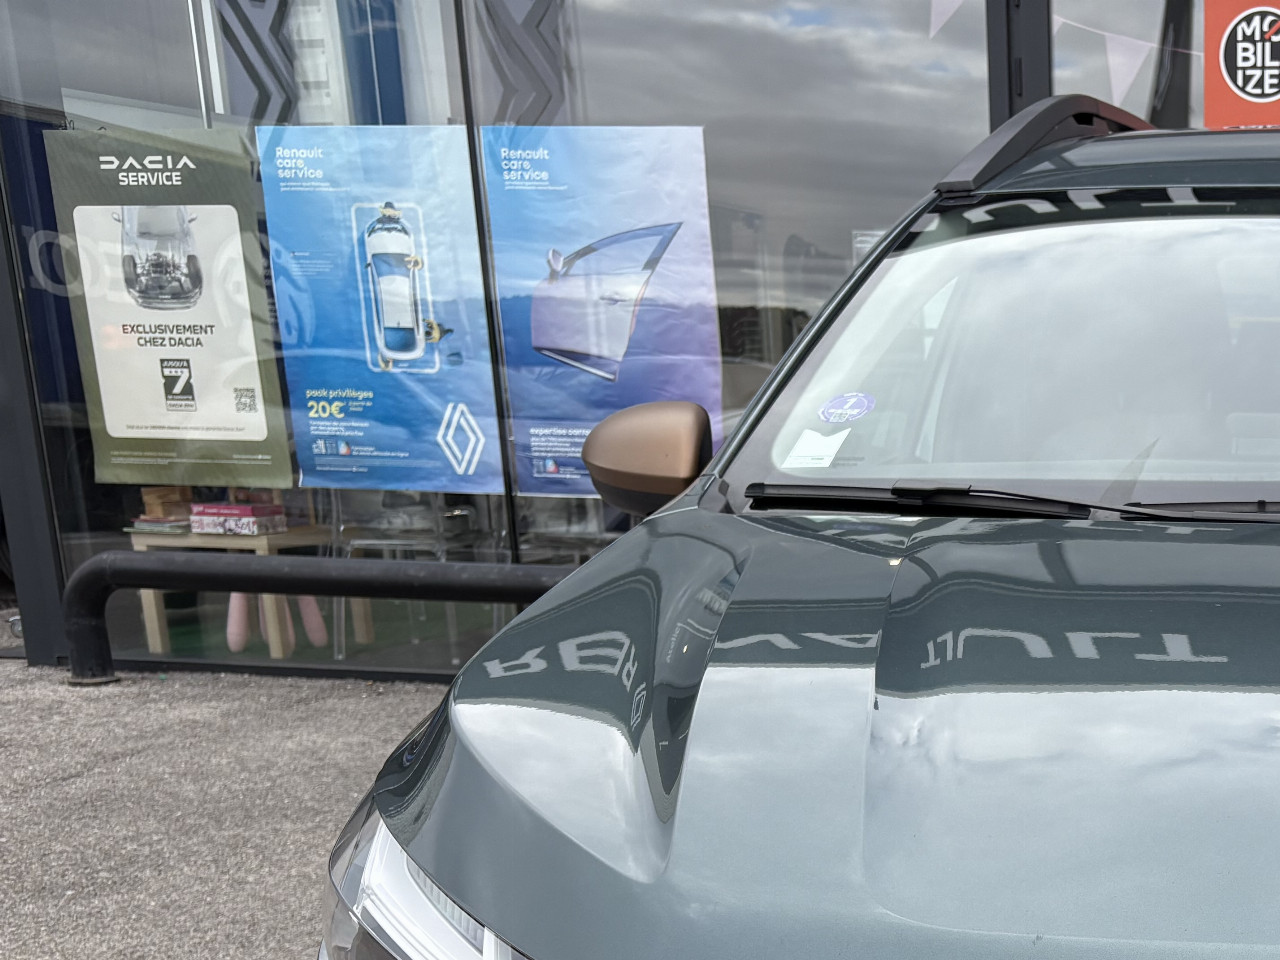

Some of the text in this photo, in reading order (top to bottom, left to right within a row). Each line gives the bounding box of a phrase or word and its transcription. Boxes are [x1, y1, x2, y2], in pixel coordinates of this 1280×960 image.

[276, 147, 324, 158] Renault
[501, 147, 549, 159] Renault
[99, 156, 197, 169] DACIA
[276, 159, 304, 168] care
[502, 160, 530, 169] care
[278, 168, 323, 178] service
[503, 170, 549, 180] service
[118, 172, 182, 185] SERVICE
[122, 324, 215, 335] EXCLUSIVEMENT
[137, 337, 204, 347] CHEZ DACIA
